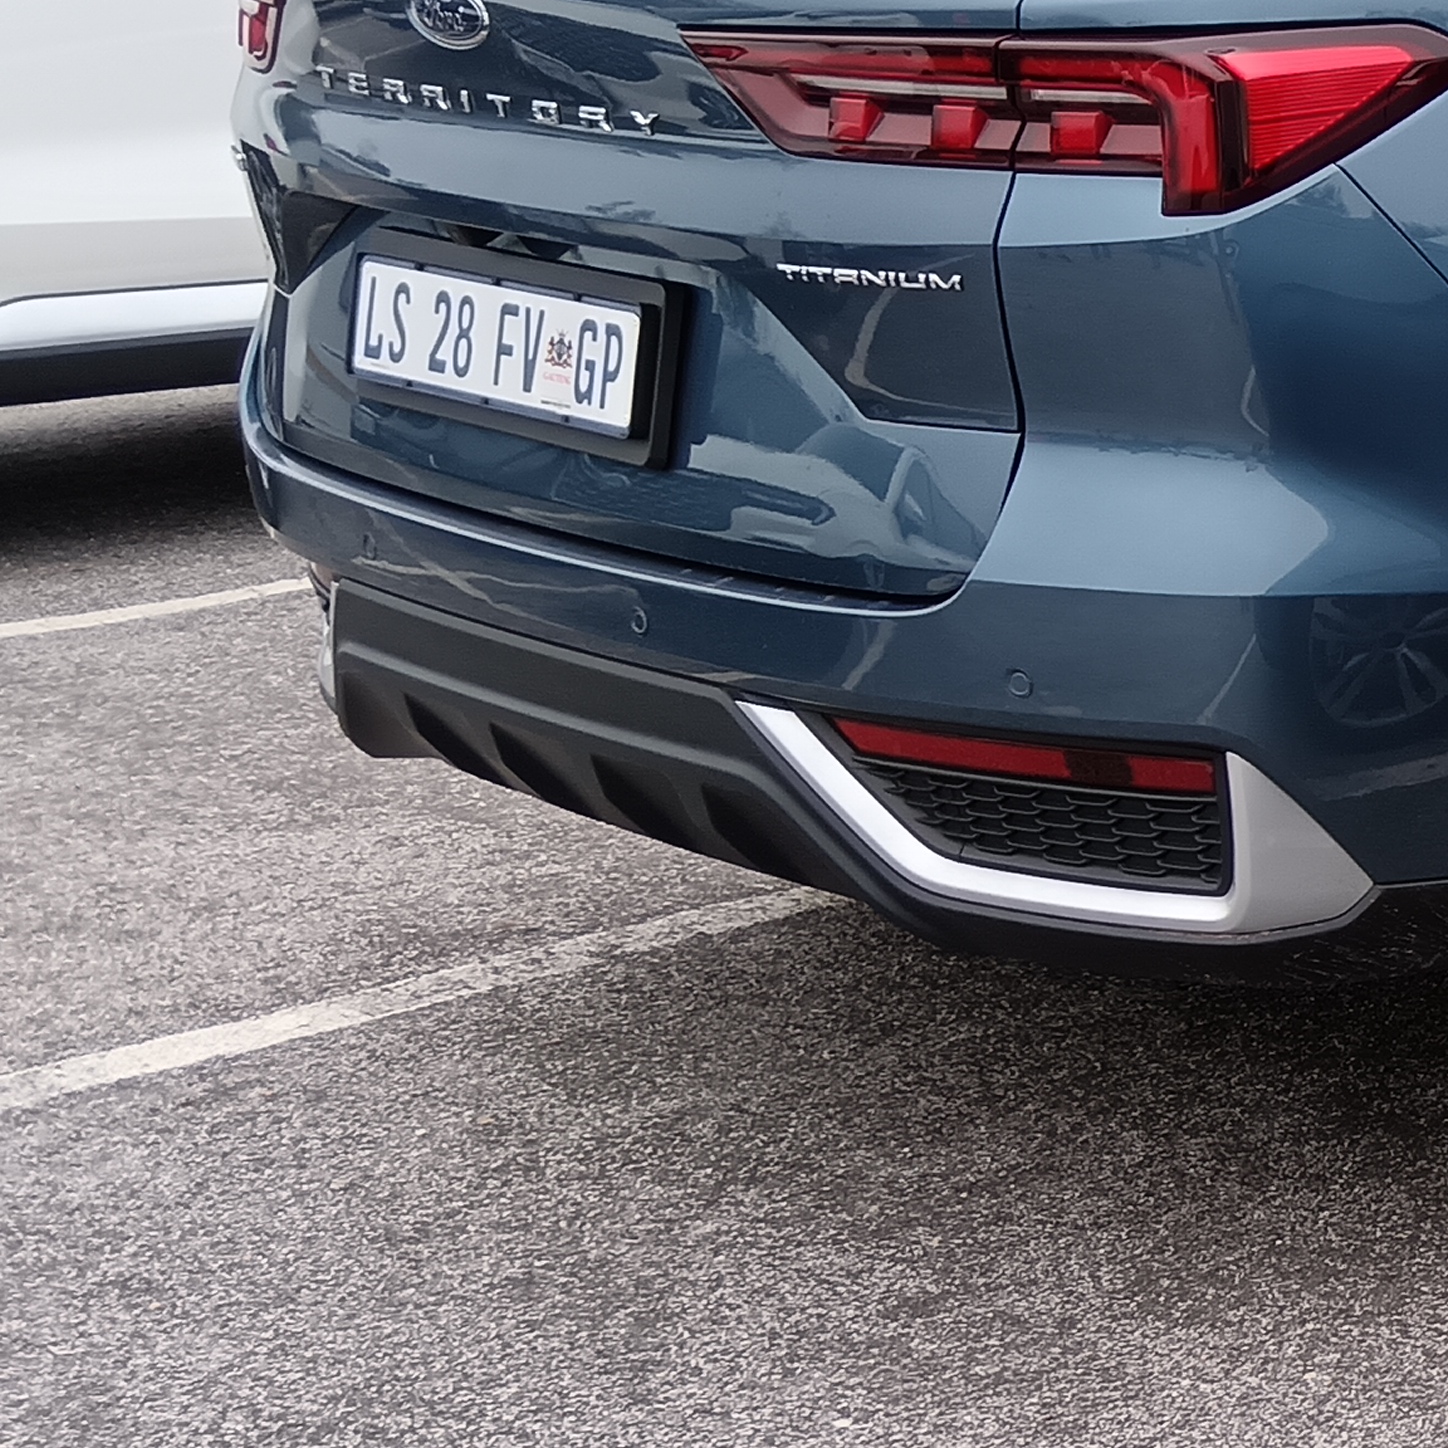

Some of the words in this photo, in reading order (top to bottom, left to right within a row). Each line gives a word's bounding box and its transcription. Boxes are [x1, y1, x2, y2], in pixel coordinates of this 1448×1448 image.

[315, 65, 661, 137] TERRITORY
[776, 263, 964, 292] TITANIUM
[363, 276, 411, 364] LS
[427, 290, 476, 378] 28
[492, 303, 546, 394] FV
[573, 318, 624, 410] GP
